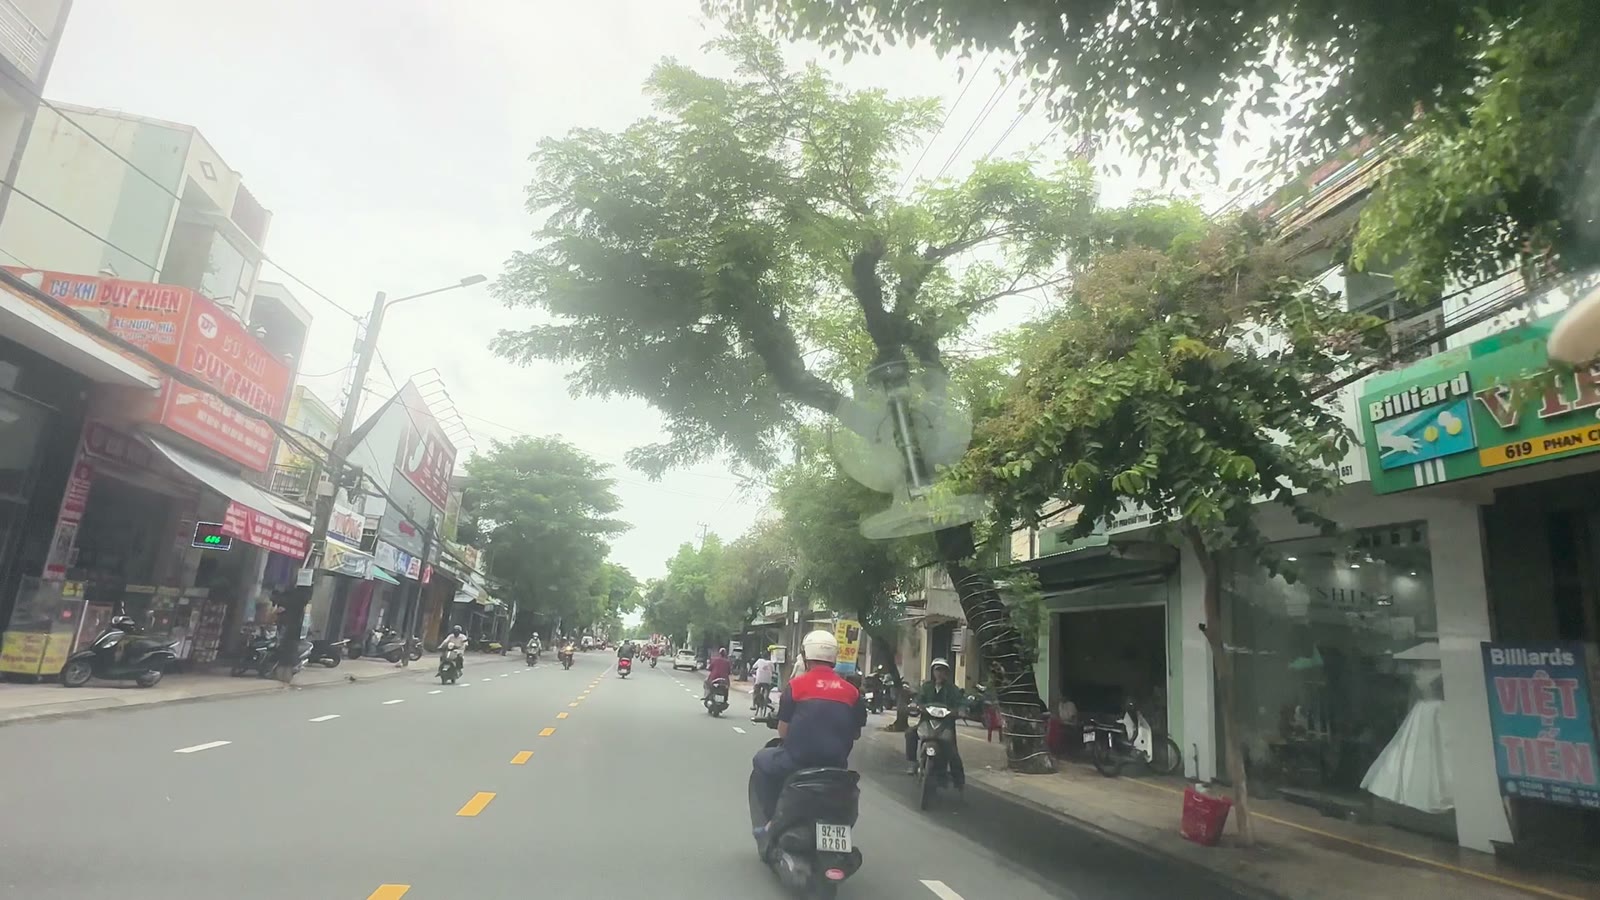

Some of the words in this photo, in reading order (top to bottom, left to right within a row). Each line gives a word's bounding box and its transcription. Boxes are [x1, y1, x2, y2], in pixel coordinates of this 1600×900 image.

[99, 282, 134, 307] DUY
[192, 345, 232, 390] DUY
[1368, 371, 1469, 422] Billiard
[1505, 442, 1532, 459] 619
[1543, 433, 1583, 451] PHAN
[1490, 648, 1575, 666] Billiards
[816, 679, 844, 691] SYM
[1494, 670, 1578, 725] VIỆT
[1501, 728, 1596, 784] TIẾN
[821, 837, 847, 851] 8260
